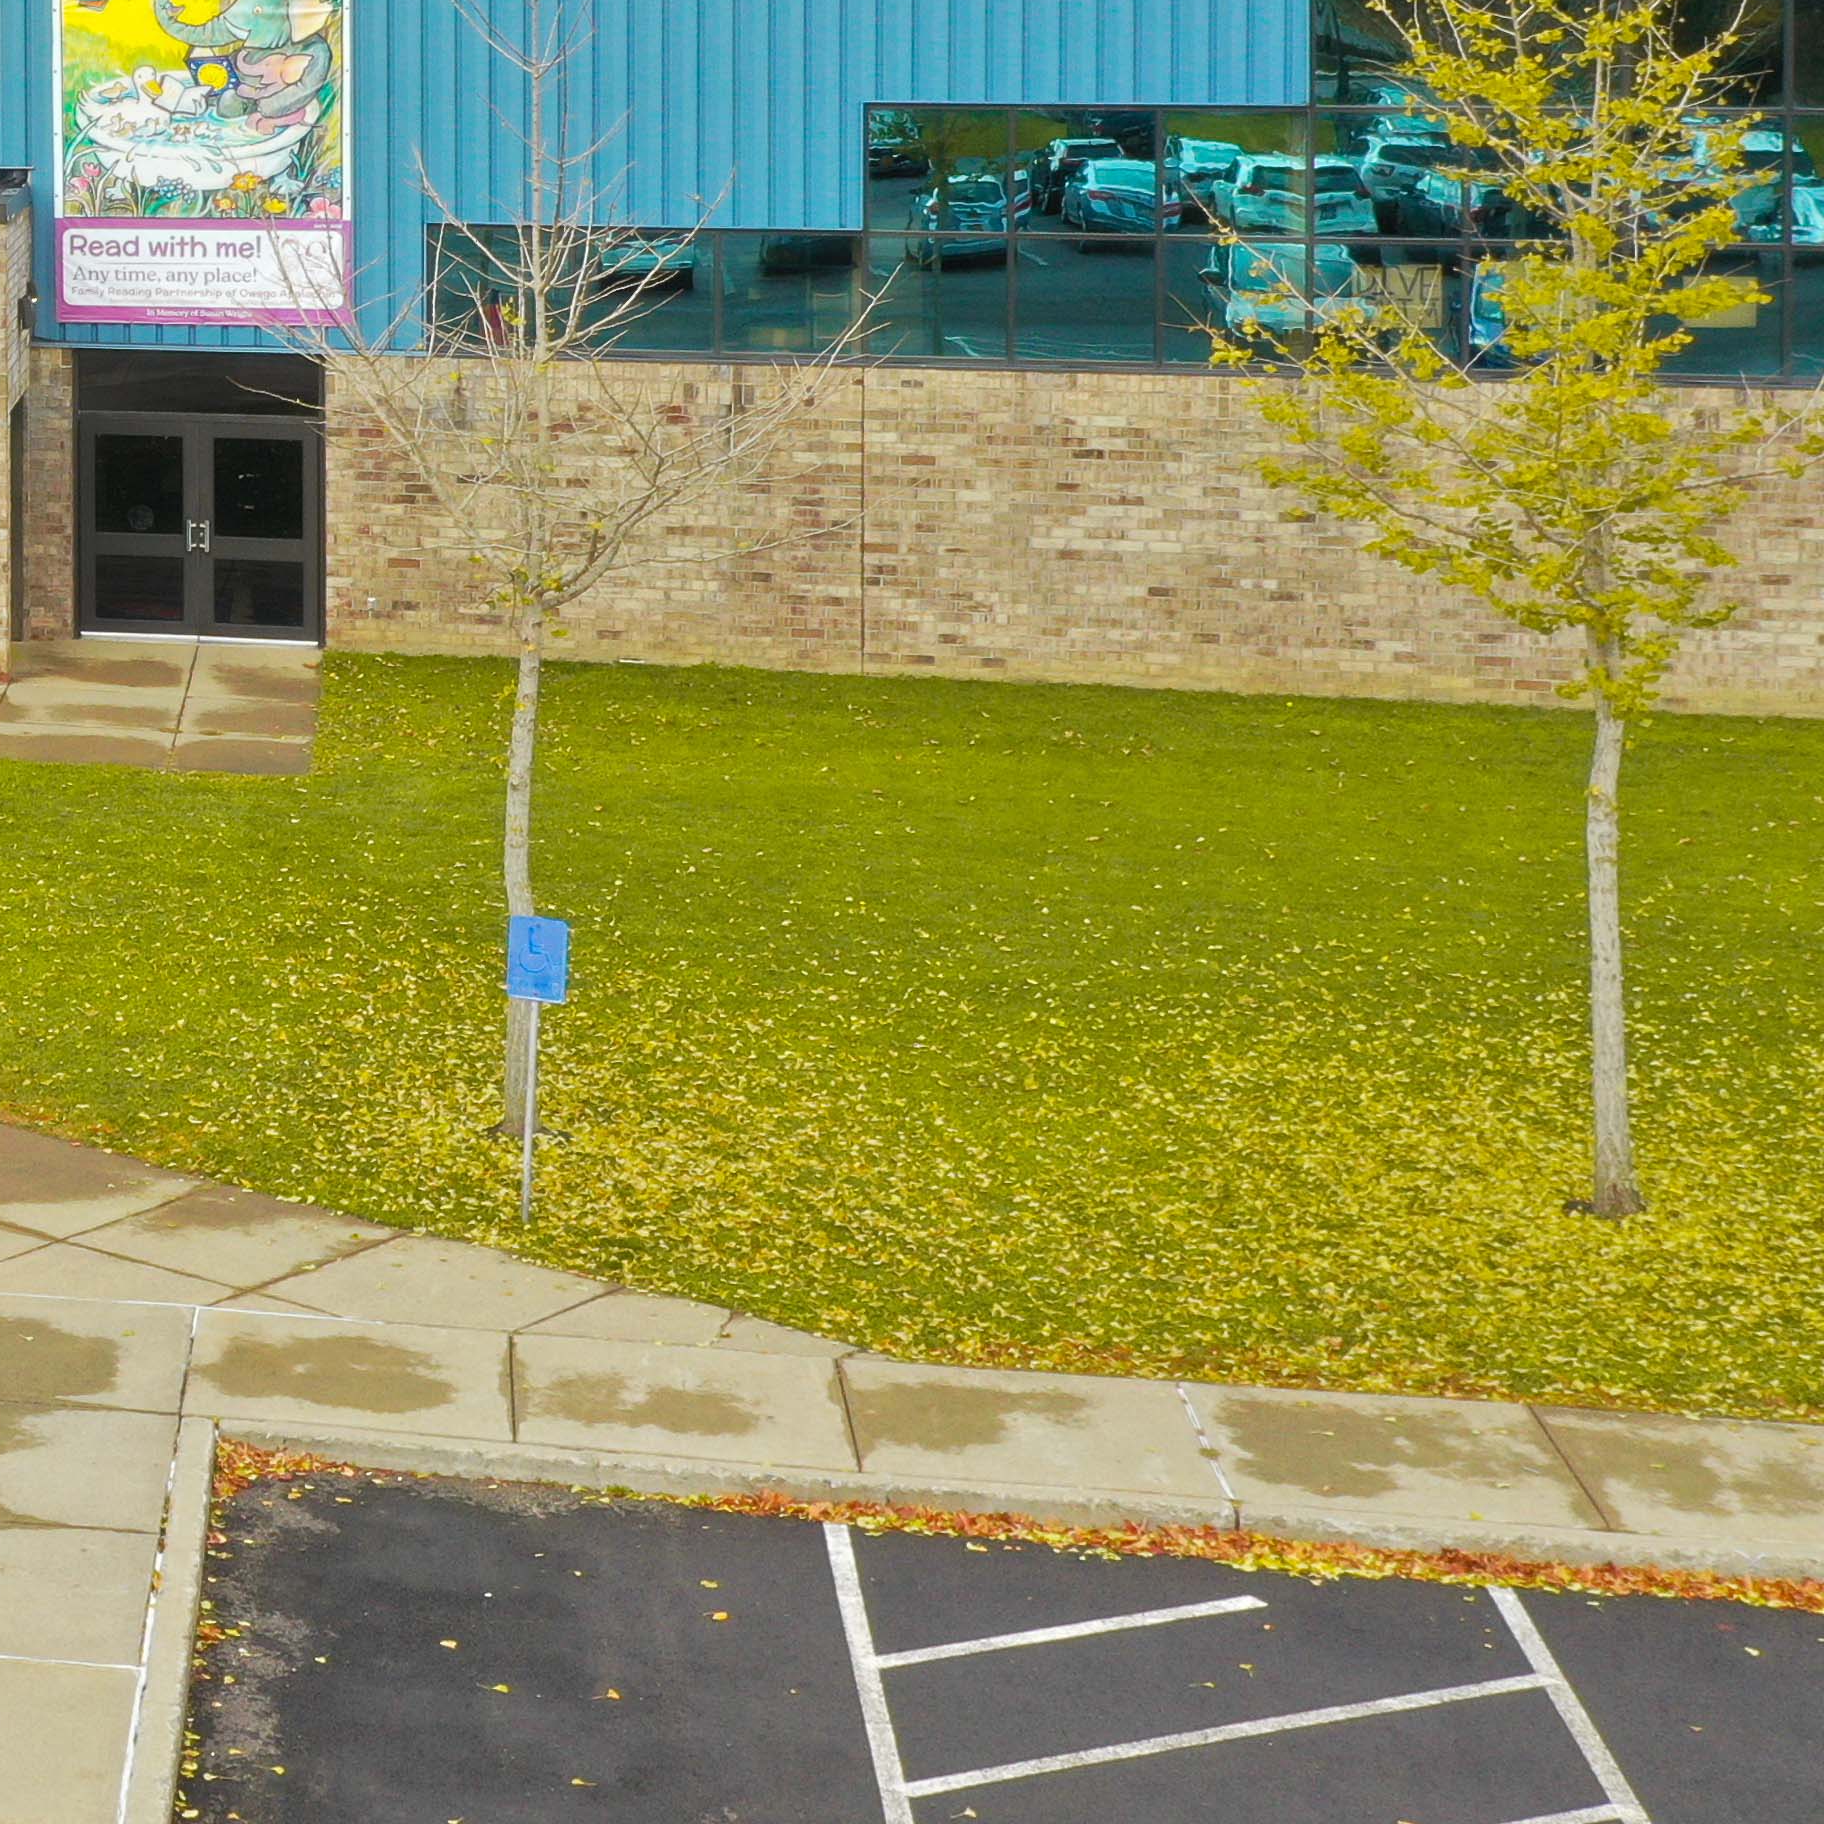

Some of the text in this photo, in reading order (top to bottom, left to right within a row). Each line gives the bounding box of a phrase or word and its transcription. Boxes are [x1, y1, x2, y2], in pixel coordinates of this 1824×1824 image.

[69, 234, 261, 259] Read with me!
[72, 265, 257, 286] Any time, any place!
[107, 286, 153, 298] Reading
[225, 289, 237, 298] of
